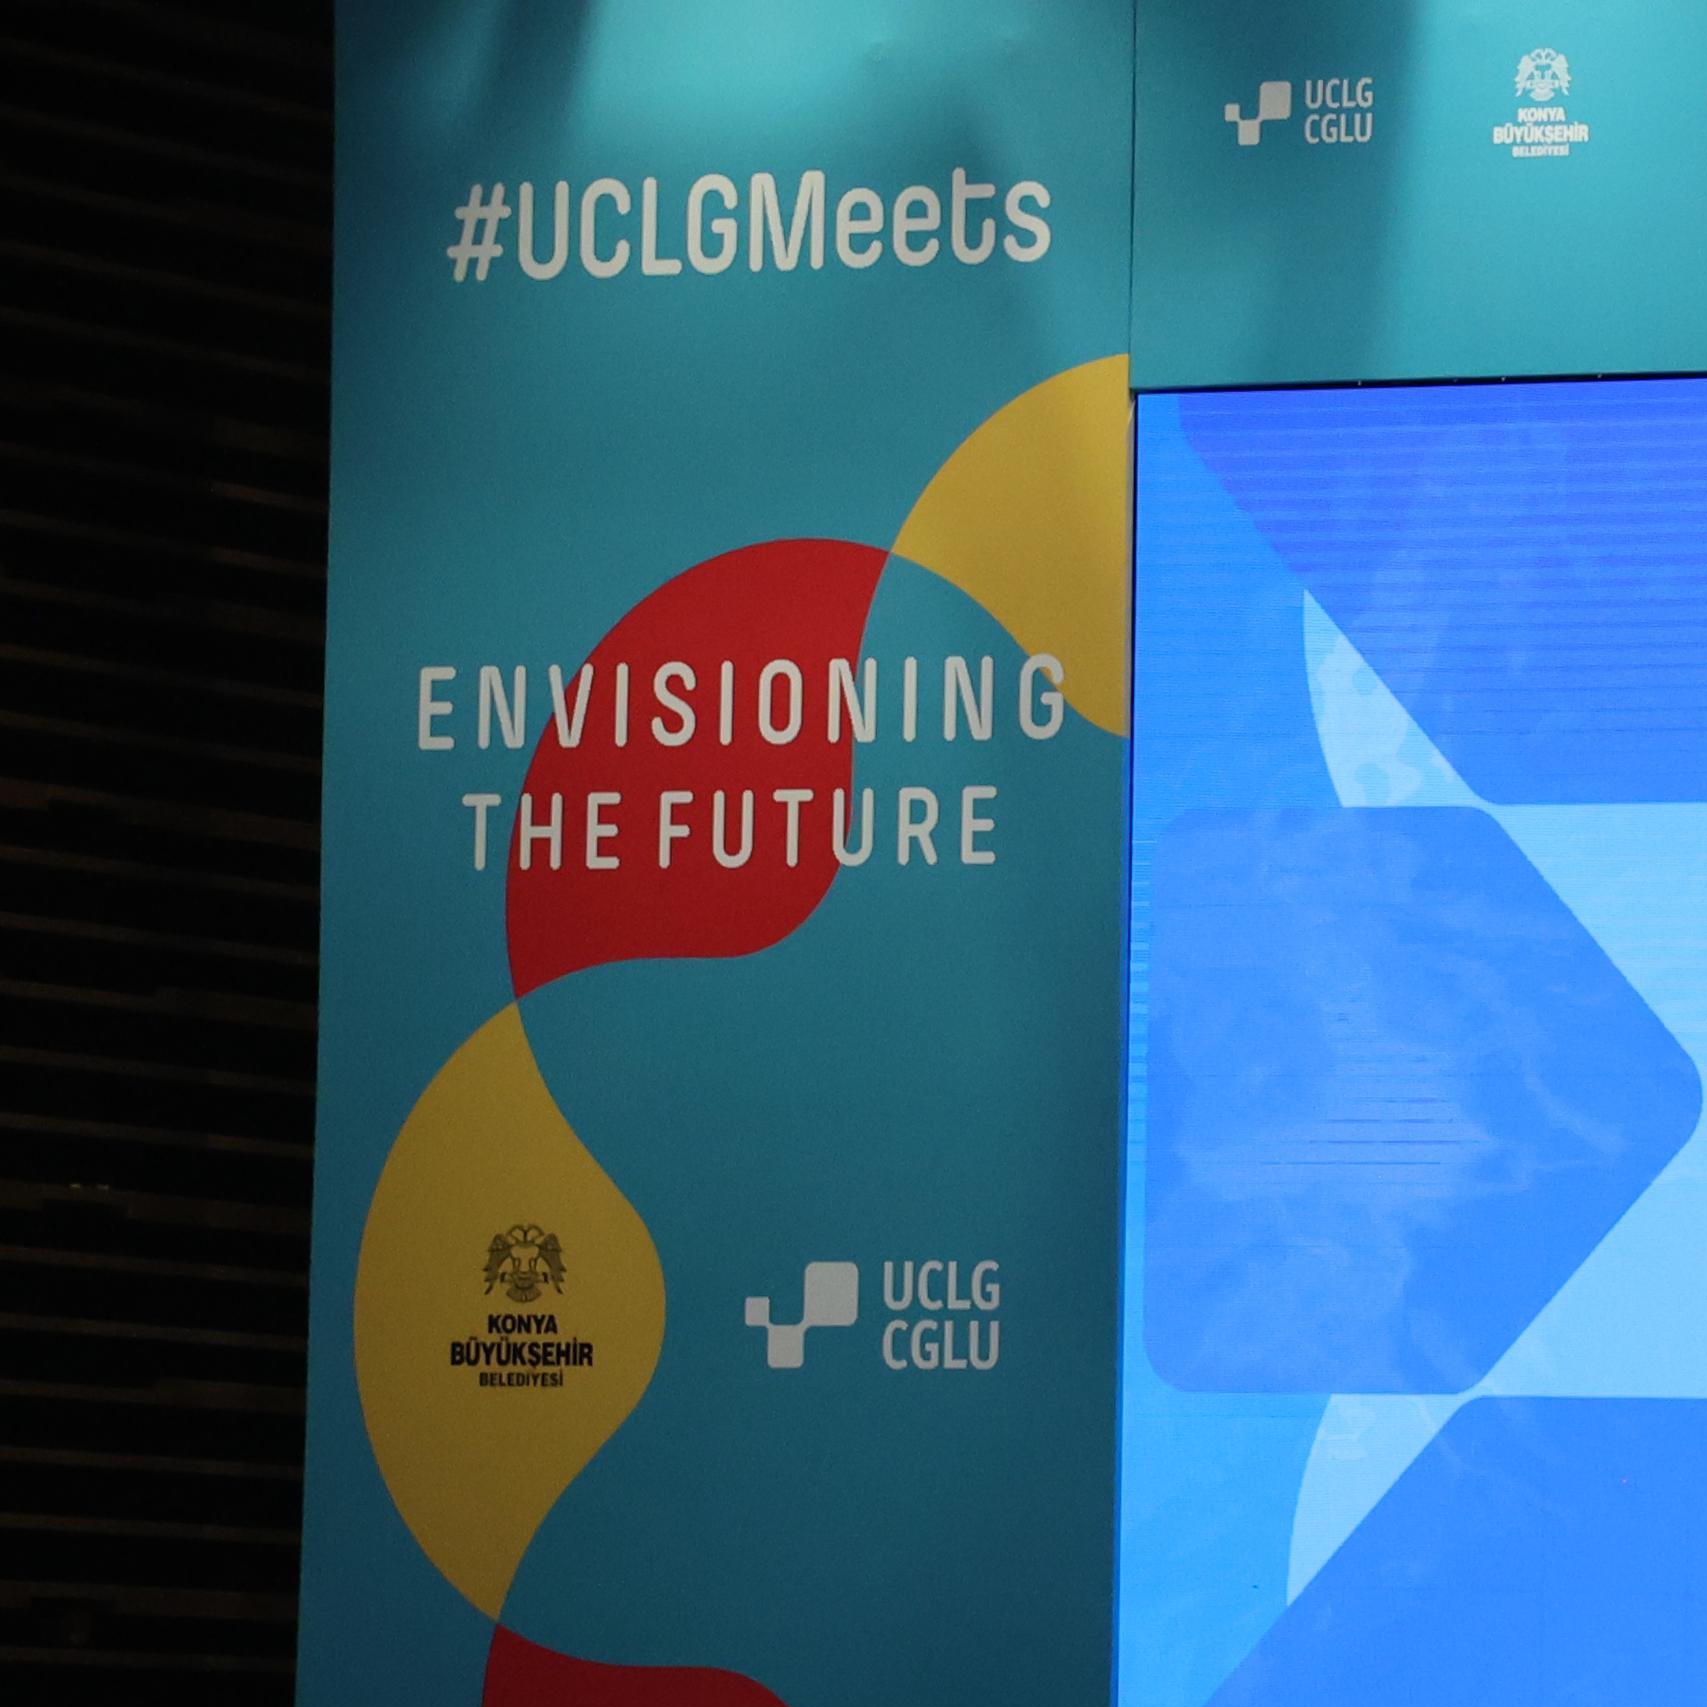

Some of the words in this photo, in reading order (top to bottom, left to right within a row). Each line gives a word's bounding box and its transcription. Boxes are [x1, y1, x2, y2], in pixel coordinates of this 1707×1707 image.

[1306, 77, 1373, 108] UCLG
[1305, 113, 1372, 143] CGLU
[1518, 108, 1566, 122] KONYA
[446, 166, 1052, 283] #UCLGMeets
[418, 653, 1066, 751] ENVISIONING
[463, 790, 621, 871] THE
[658, 784, 998, 871] FUTURE
[884, 1260, 999, 1310] UCLG
[488, 1314, 557, 1334] KONYA
[451, 1337, 593, 1368] BÜYÜKŞEHİR
[883, 1320, 999, 1369] CGLU
